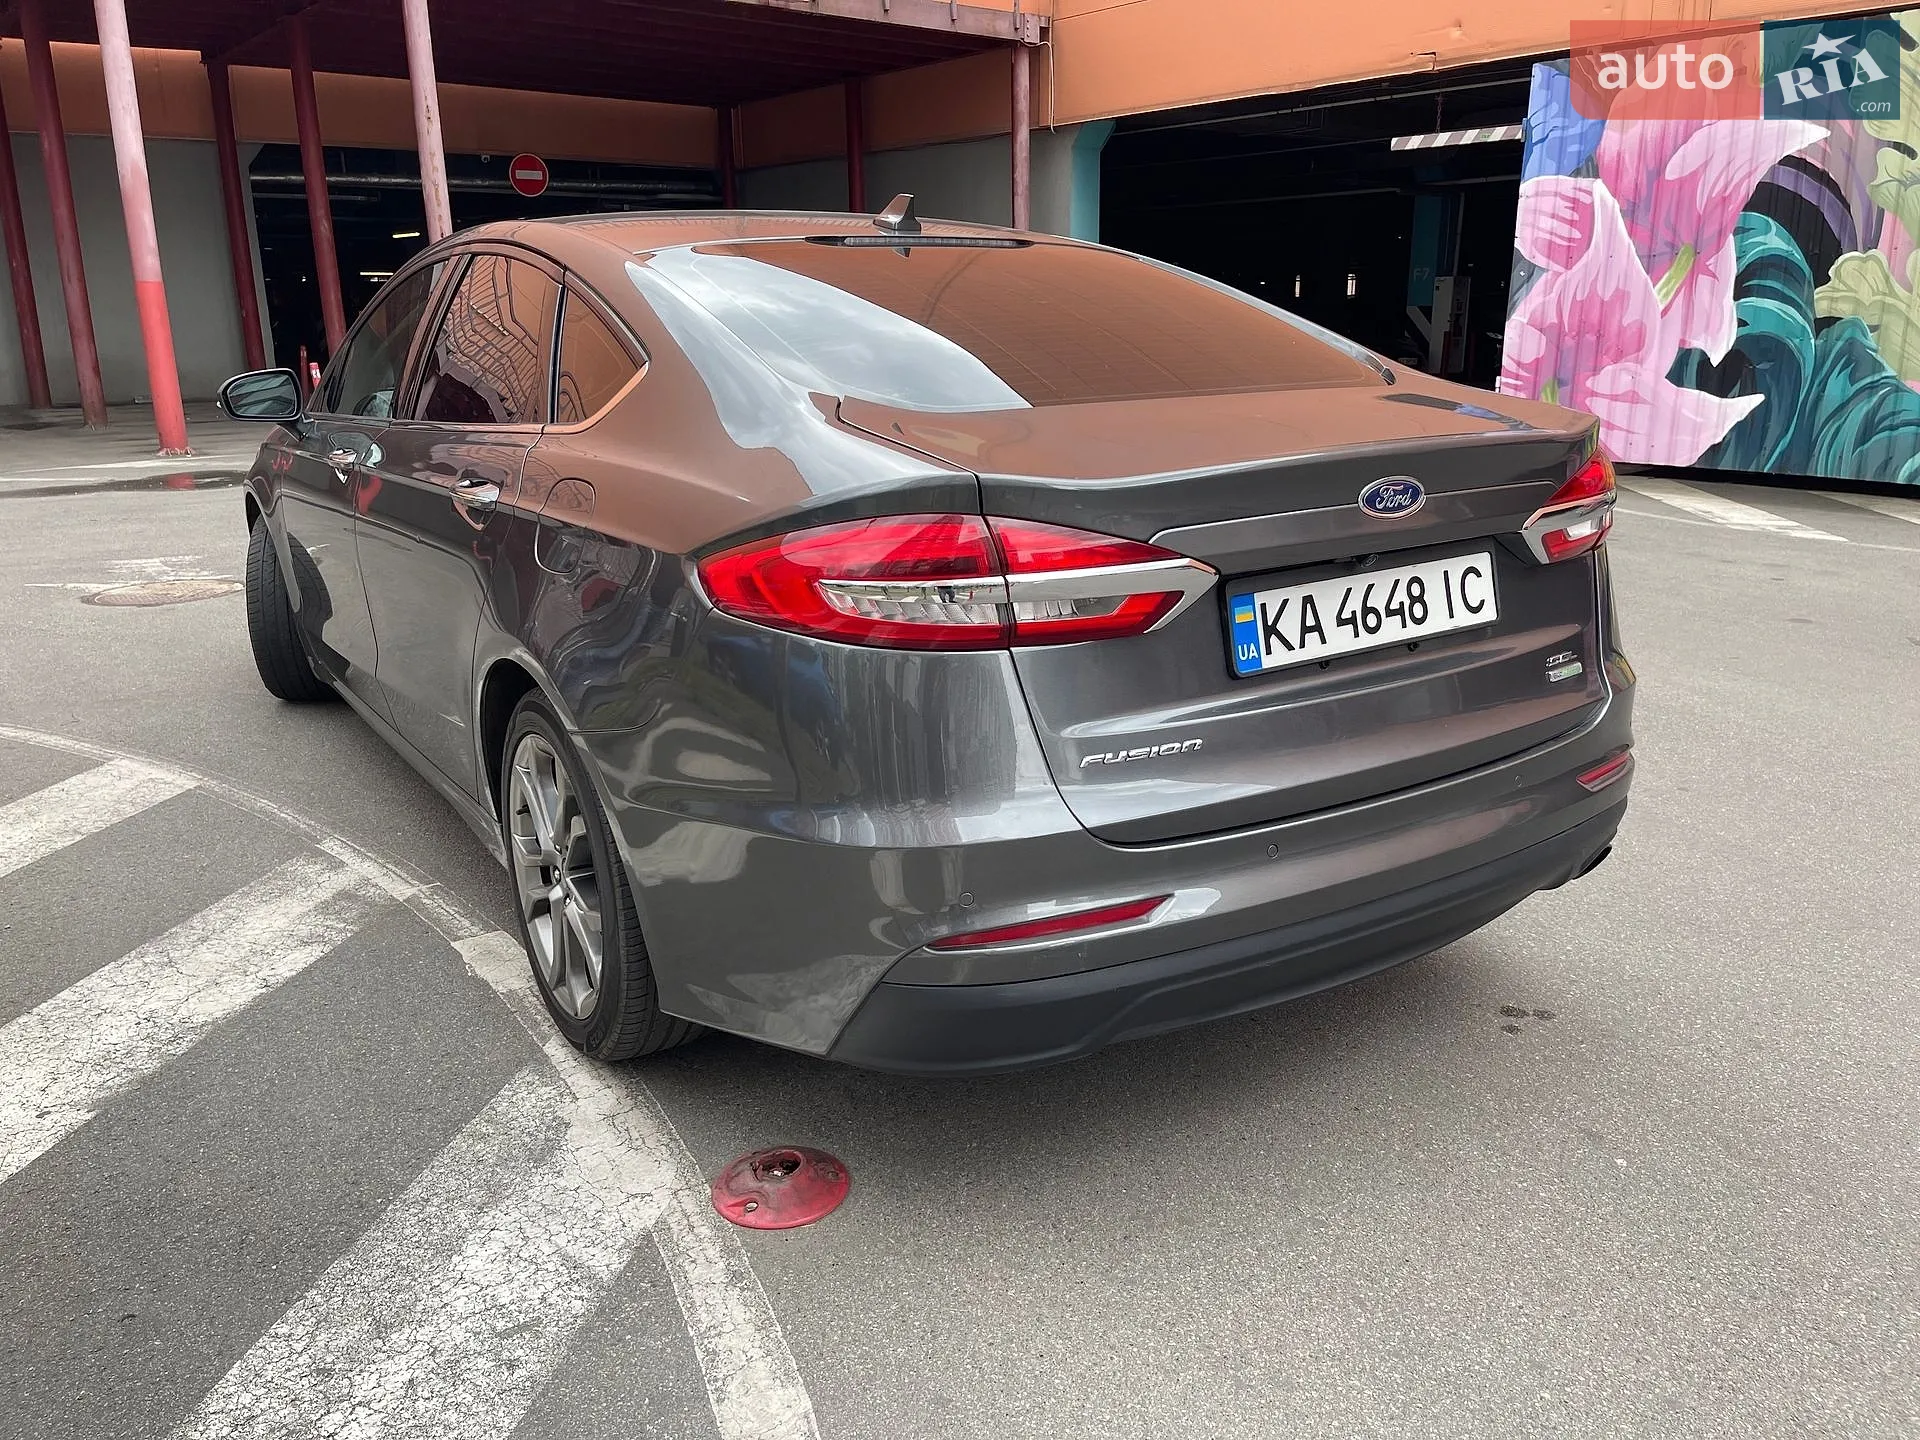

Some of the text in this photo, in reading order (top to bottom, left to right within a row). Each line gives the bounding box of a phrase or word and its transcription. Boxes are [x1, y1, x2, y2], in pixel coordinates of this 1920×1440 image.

[1375, 484, 1412, 509] Ford
[1260, 565, 1486, 656] KA 4648 IC
[1238, 642, 1259, 662] UA
[1079, 738, 1203, 768] FUSION
